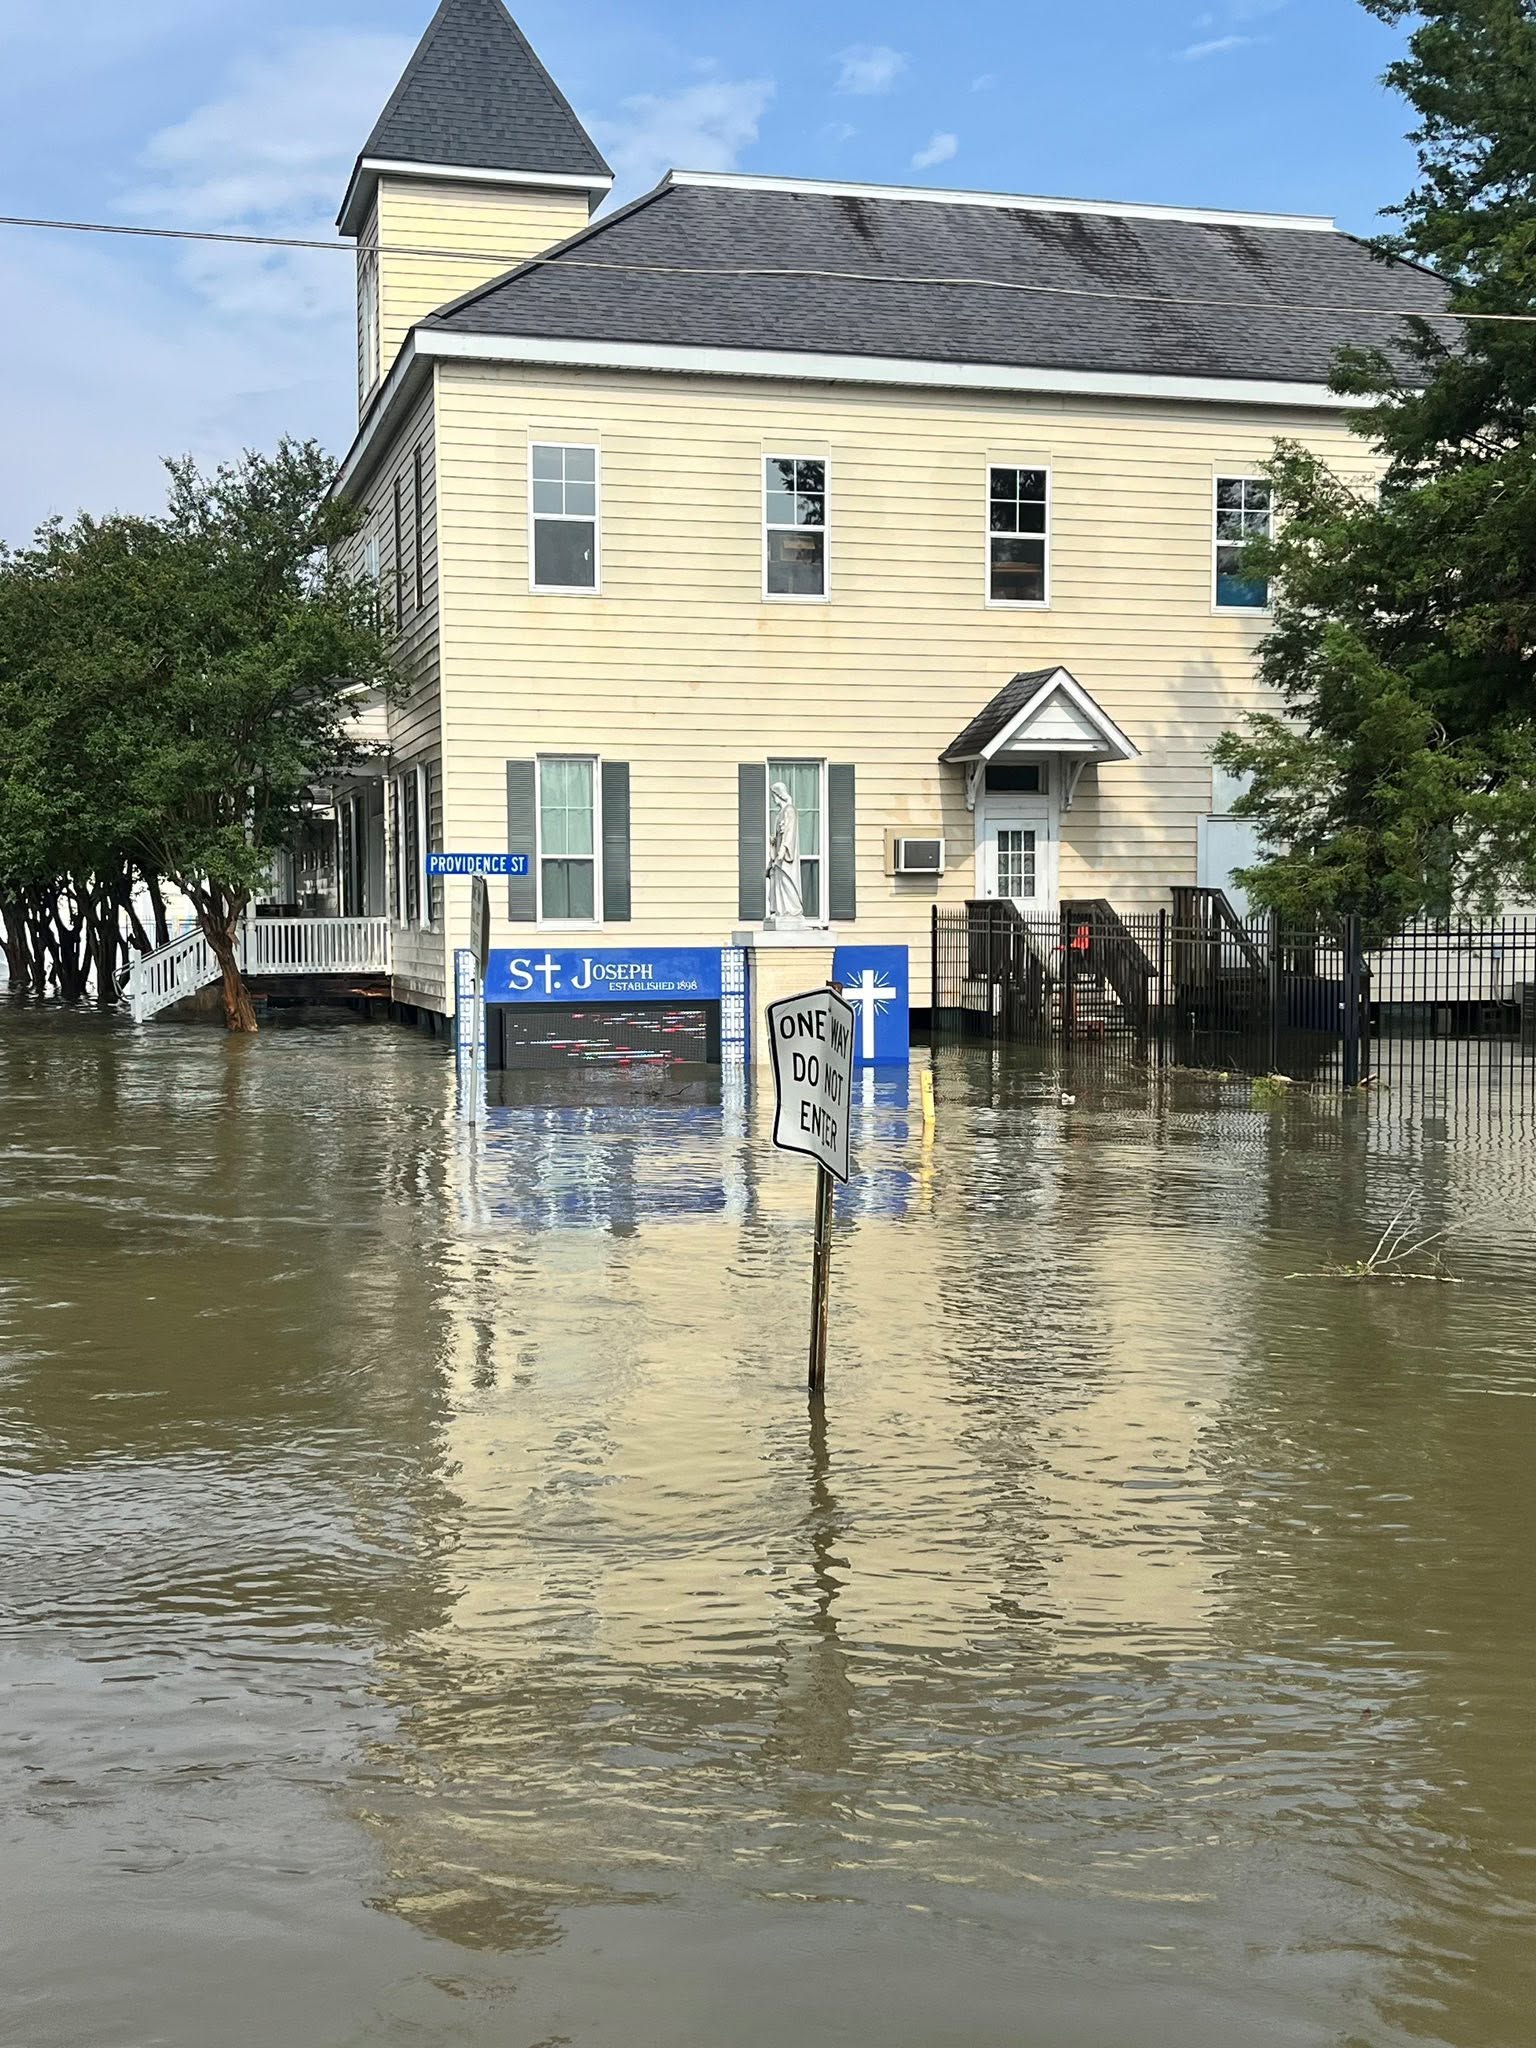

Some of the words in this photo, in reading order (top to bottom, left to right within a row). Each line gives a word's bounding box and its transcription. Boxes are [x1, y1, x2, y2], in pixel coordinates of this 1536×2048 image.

[430, 856, 507, 872] PROVIDENCE
[510, 856, 525, 872] ST
[570, 958, 653, 989] JOSEPH
[608, 982, 674, 992] ESTABLISHED
[676, 979, 698, 991] 1898
[779, 1010, 827, 1042] ONE
[830, 1015, 849, 1060] WAY
[792, 1051, 819, 1087] DO
[824, 1063, 844, 1106] NOT
[800, 1099, 837, 1152] ENTER
